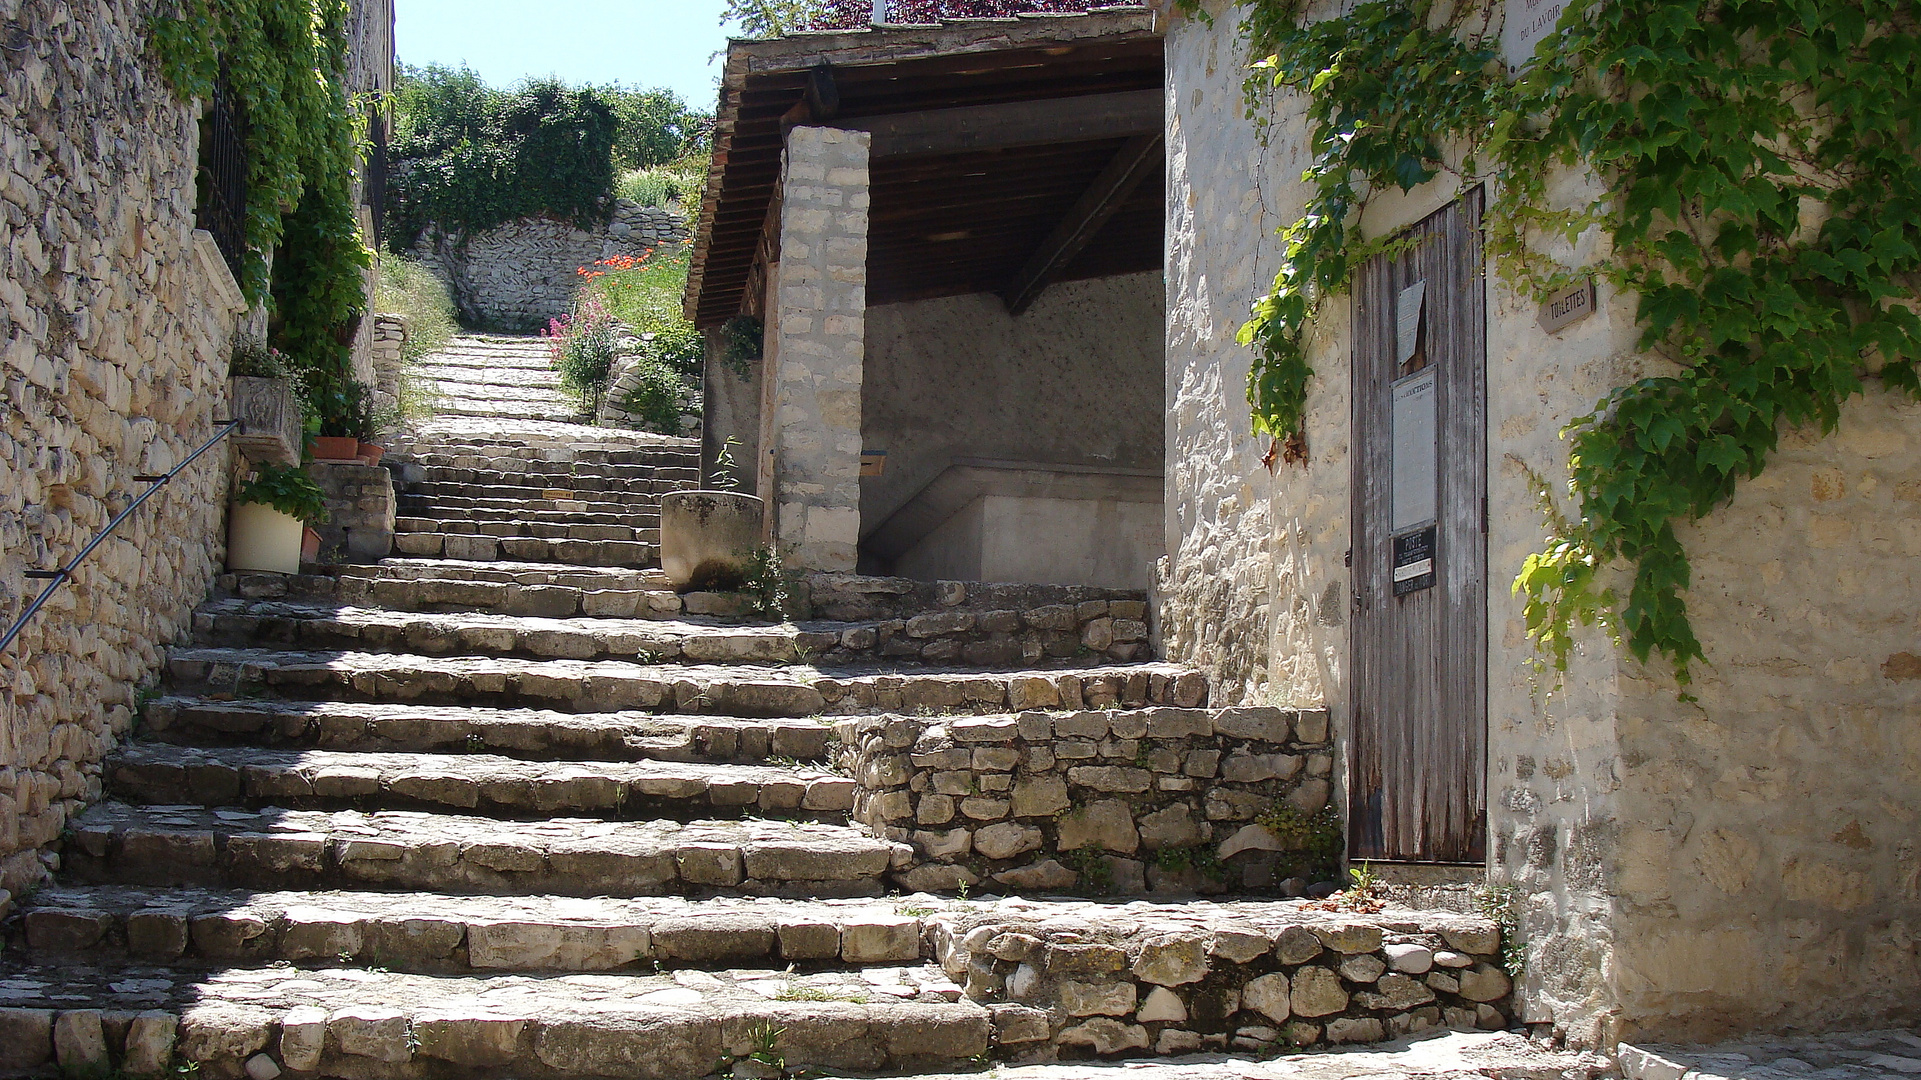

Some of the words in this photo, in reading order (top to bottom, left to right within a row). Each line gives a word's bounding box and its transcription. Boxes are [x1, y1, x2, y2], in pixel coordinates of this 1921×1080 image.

[1520, 27, 1530, 41] DU
[1532, 4, 1560, 33] LAVOIR
[1550, 289, 1586, 320] TOILETTES
